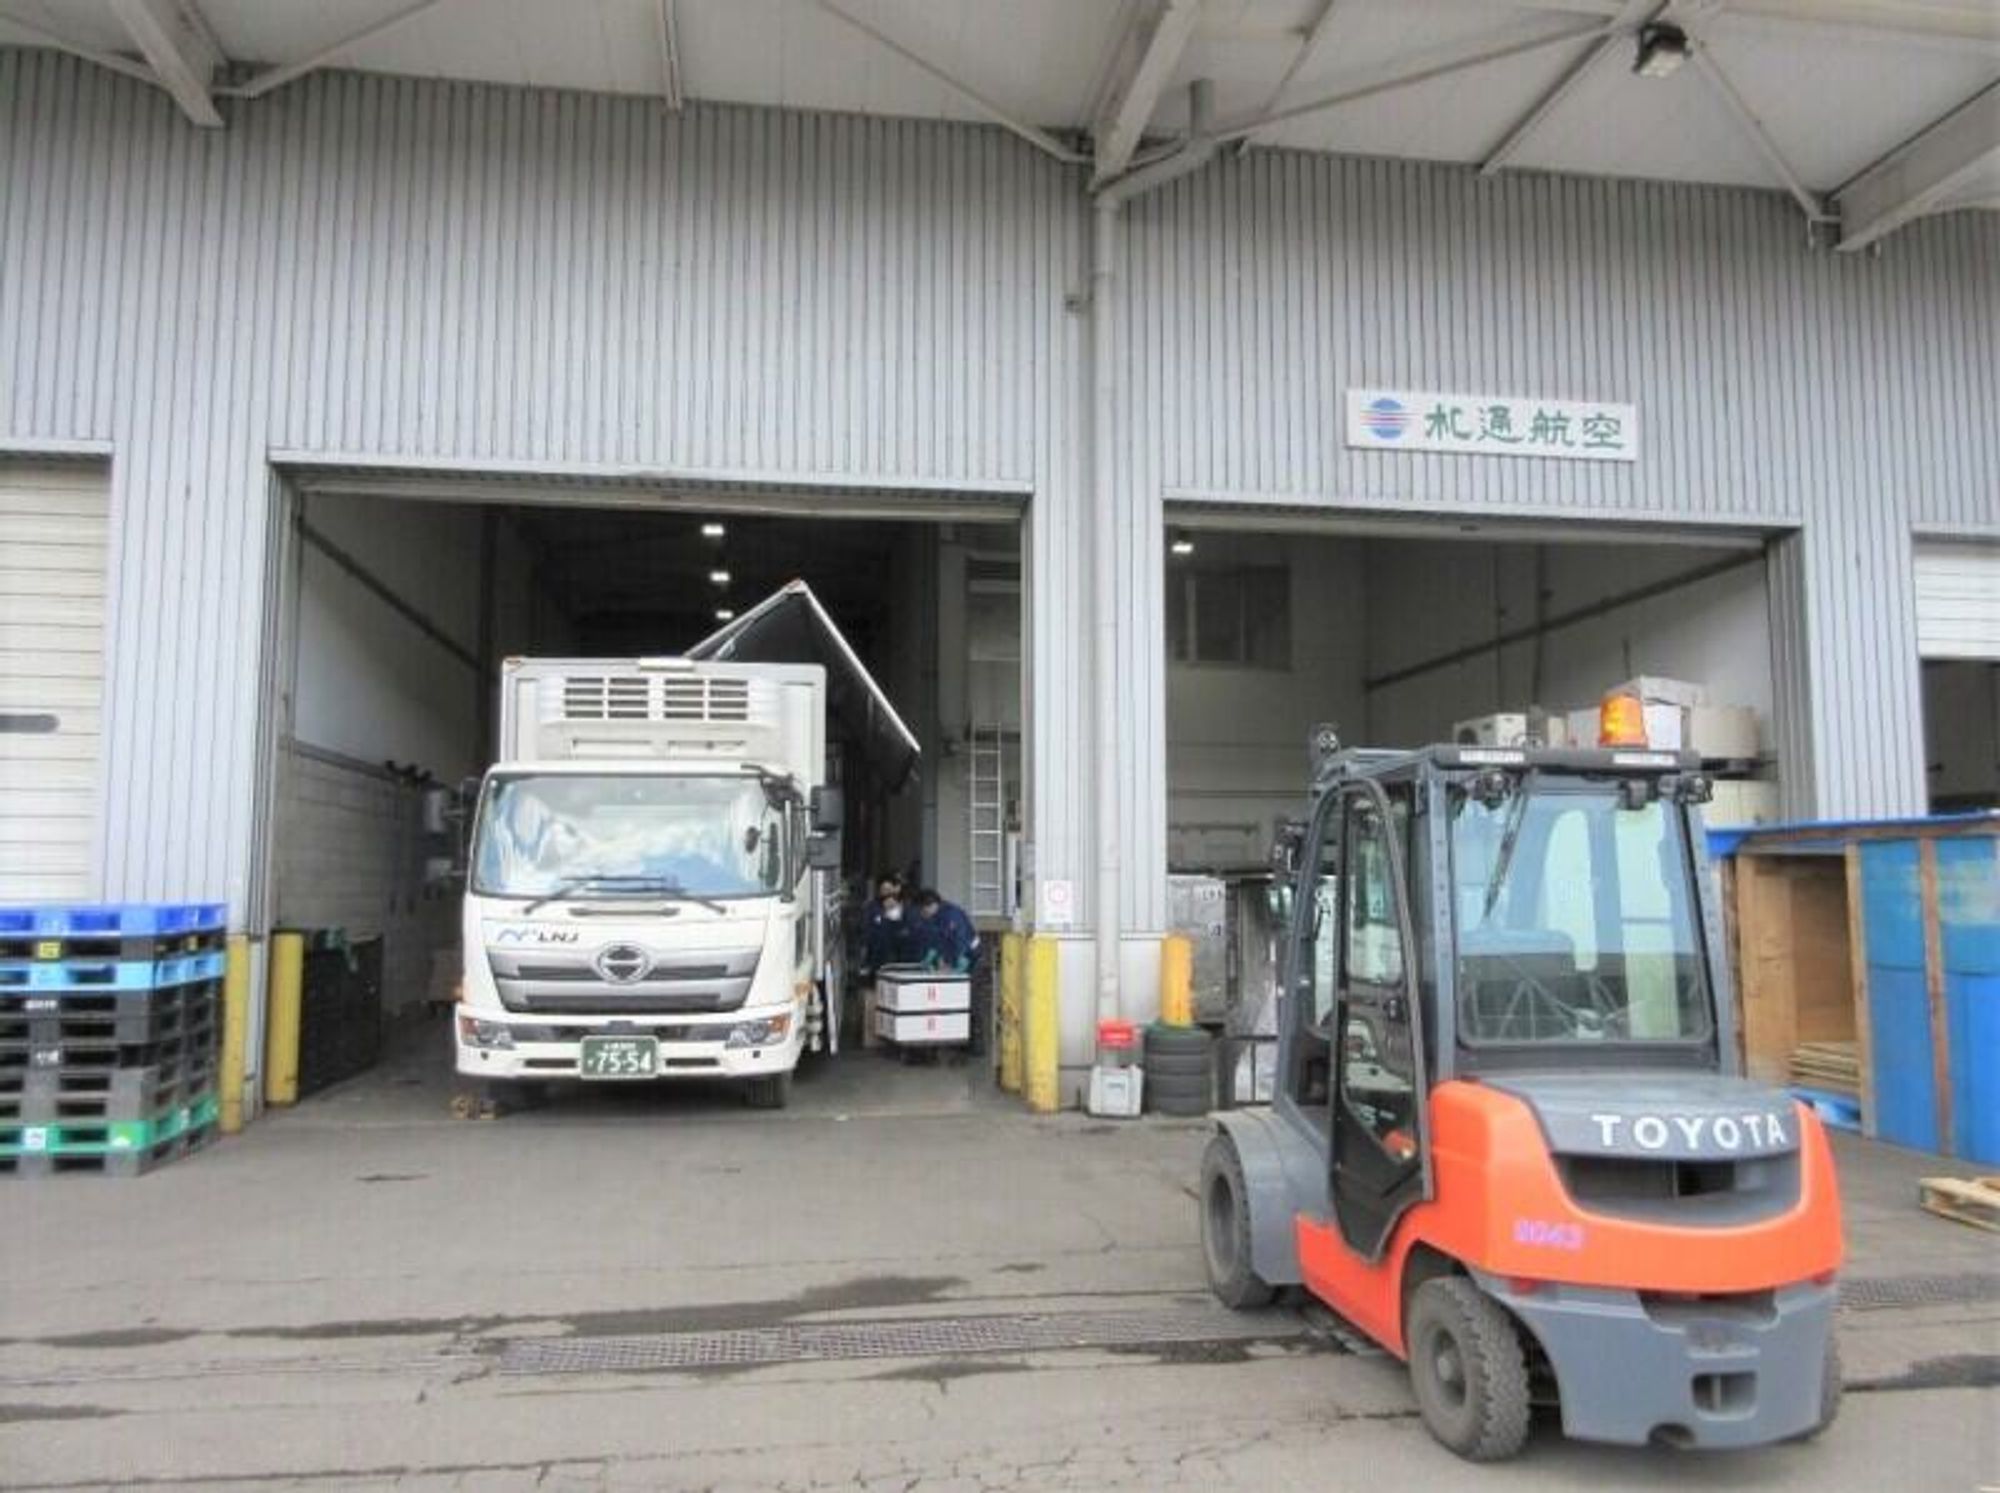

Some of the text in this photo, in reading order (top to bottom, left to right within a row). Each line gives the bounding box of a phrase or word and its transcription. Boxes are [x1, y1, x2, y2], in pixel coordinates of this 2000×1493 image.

[1424, 402, 1625, 450] 札通航空
[1592, 1114, 1788, 1150] TOYOTA
